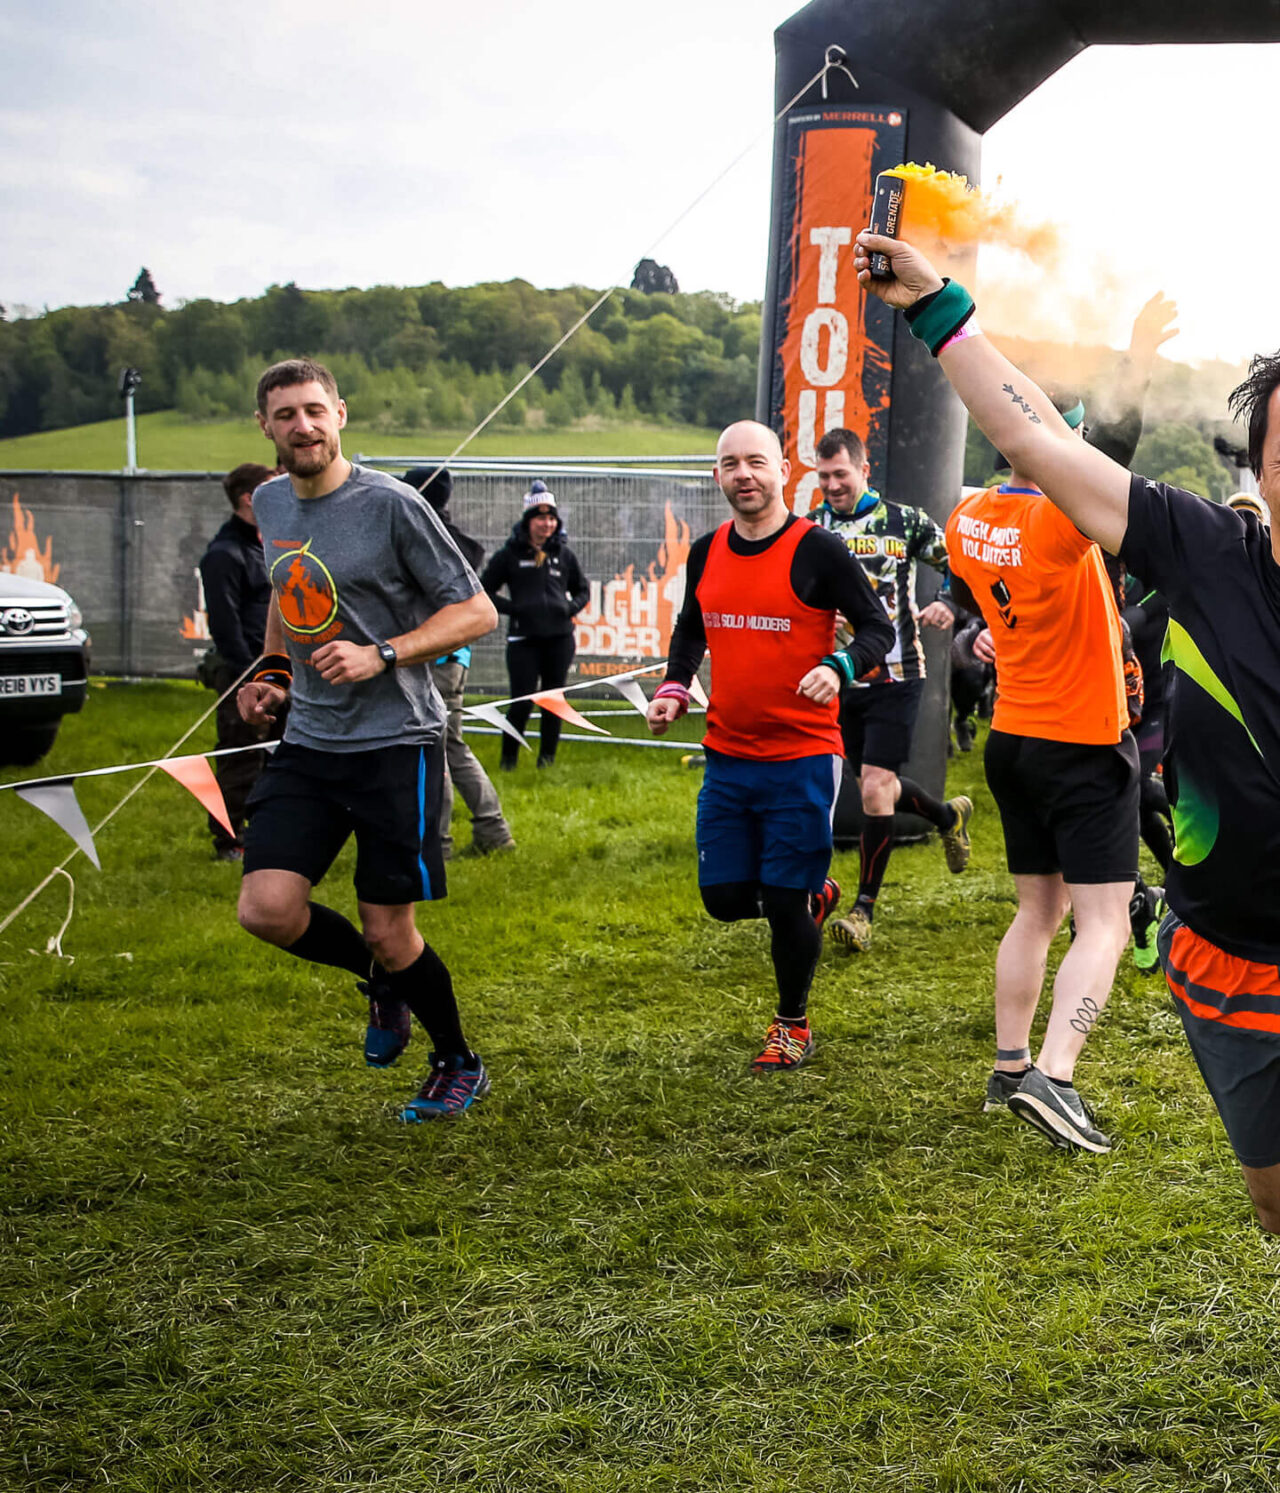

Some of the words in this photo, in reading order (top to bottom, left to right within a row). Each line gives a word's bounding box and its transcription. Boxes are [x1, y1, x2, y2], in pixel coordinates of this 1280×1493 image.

[822, 112, 885, 123] MERRELL
[886, 190, 900, 235] GRENADE
[885, 539, 905, 558] UK
[577, 580, 658, 628] UGH
[721, 613, 744, 629] SOLO
[746, 615, 791, 632] MUDDERS
[571, 625, 661, 658] DDER
[30, 676, 57, 692] VYS
